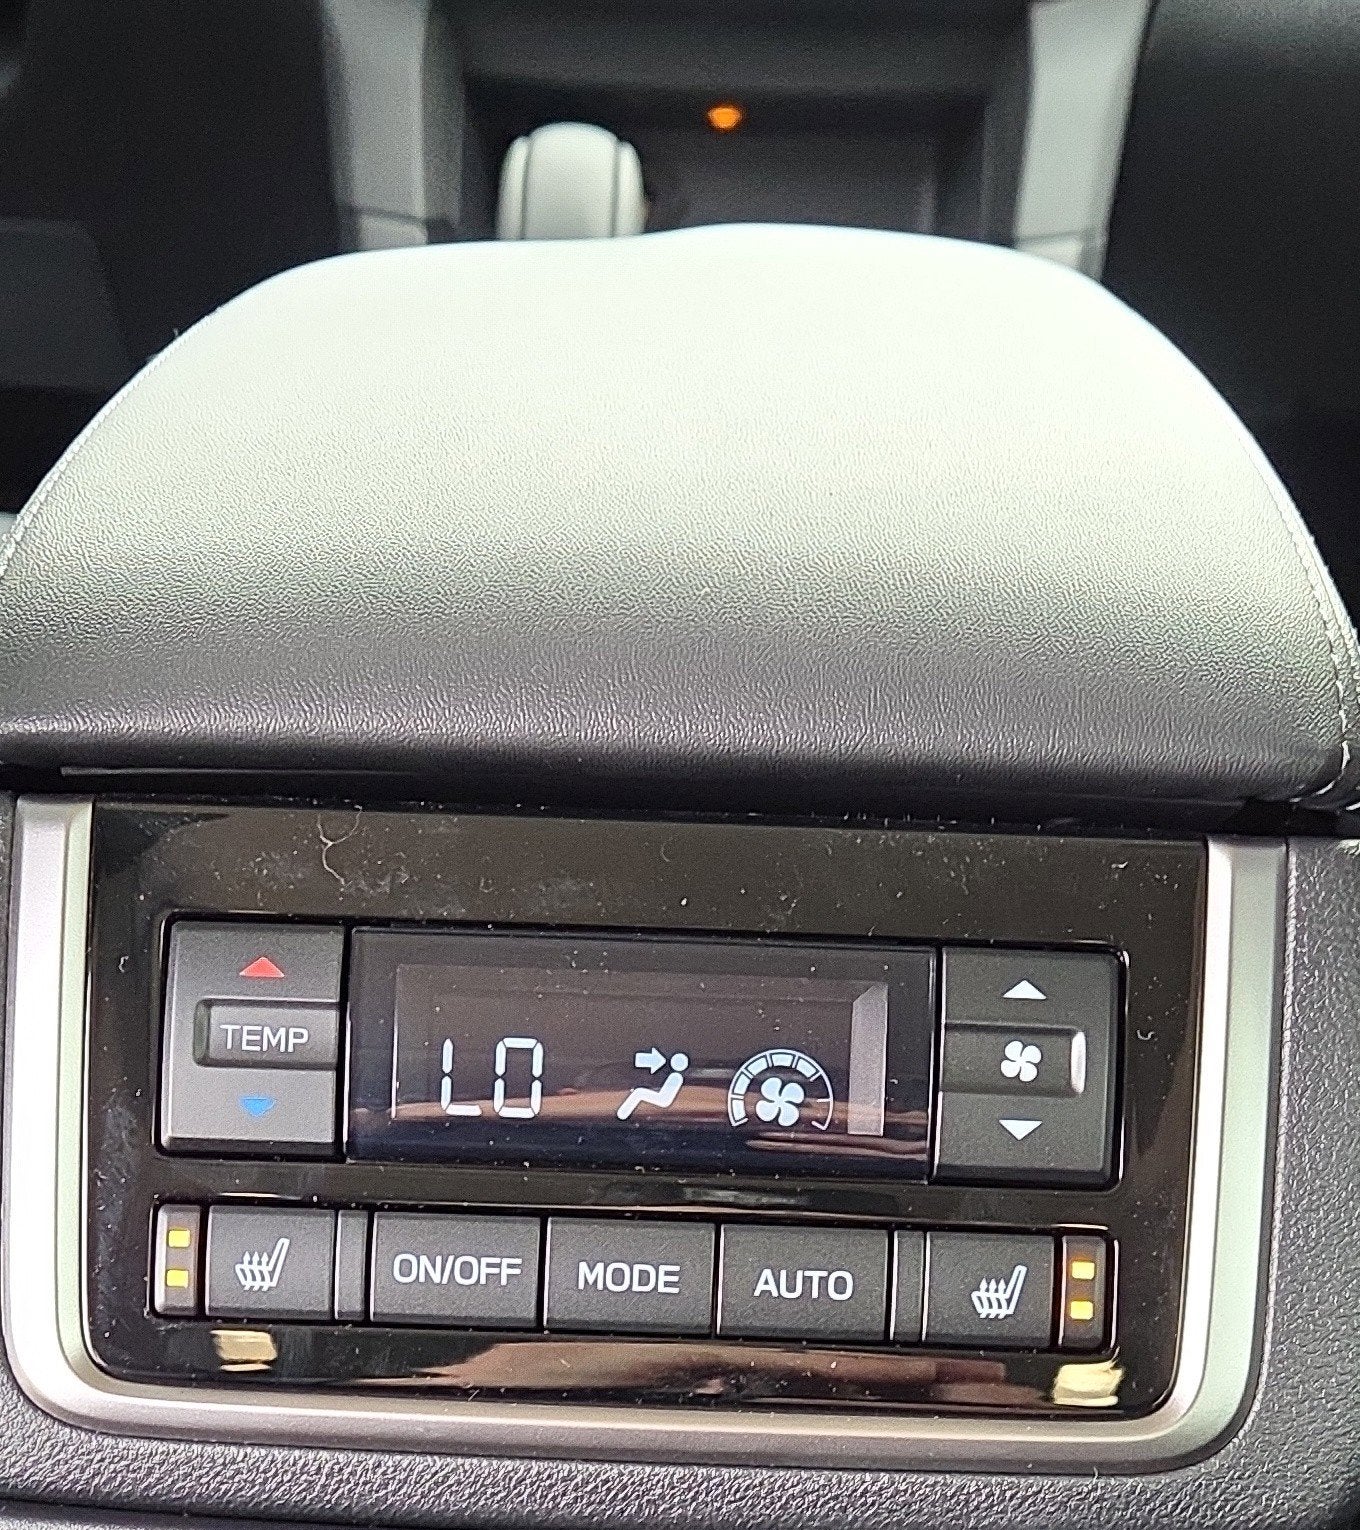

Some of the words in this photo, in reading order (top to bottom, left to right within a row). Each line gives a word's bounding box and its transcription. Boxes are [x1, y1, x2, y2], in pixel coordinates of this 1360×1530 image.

[220, 1024, 310, 1054] TEMP
[440, 1037, 544, 1119] LO
[392, 1253, 523, 1287] ON/OFF
[577, 1261, 681, 1294] MODE
[753, 1268, 854, 1301] AUTO
